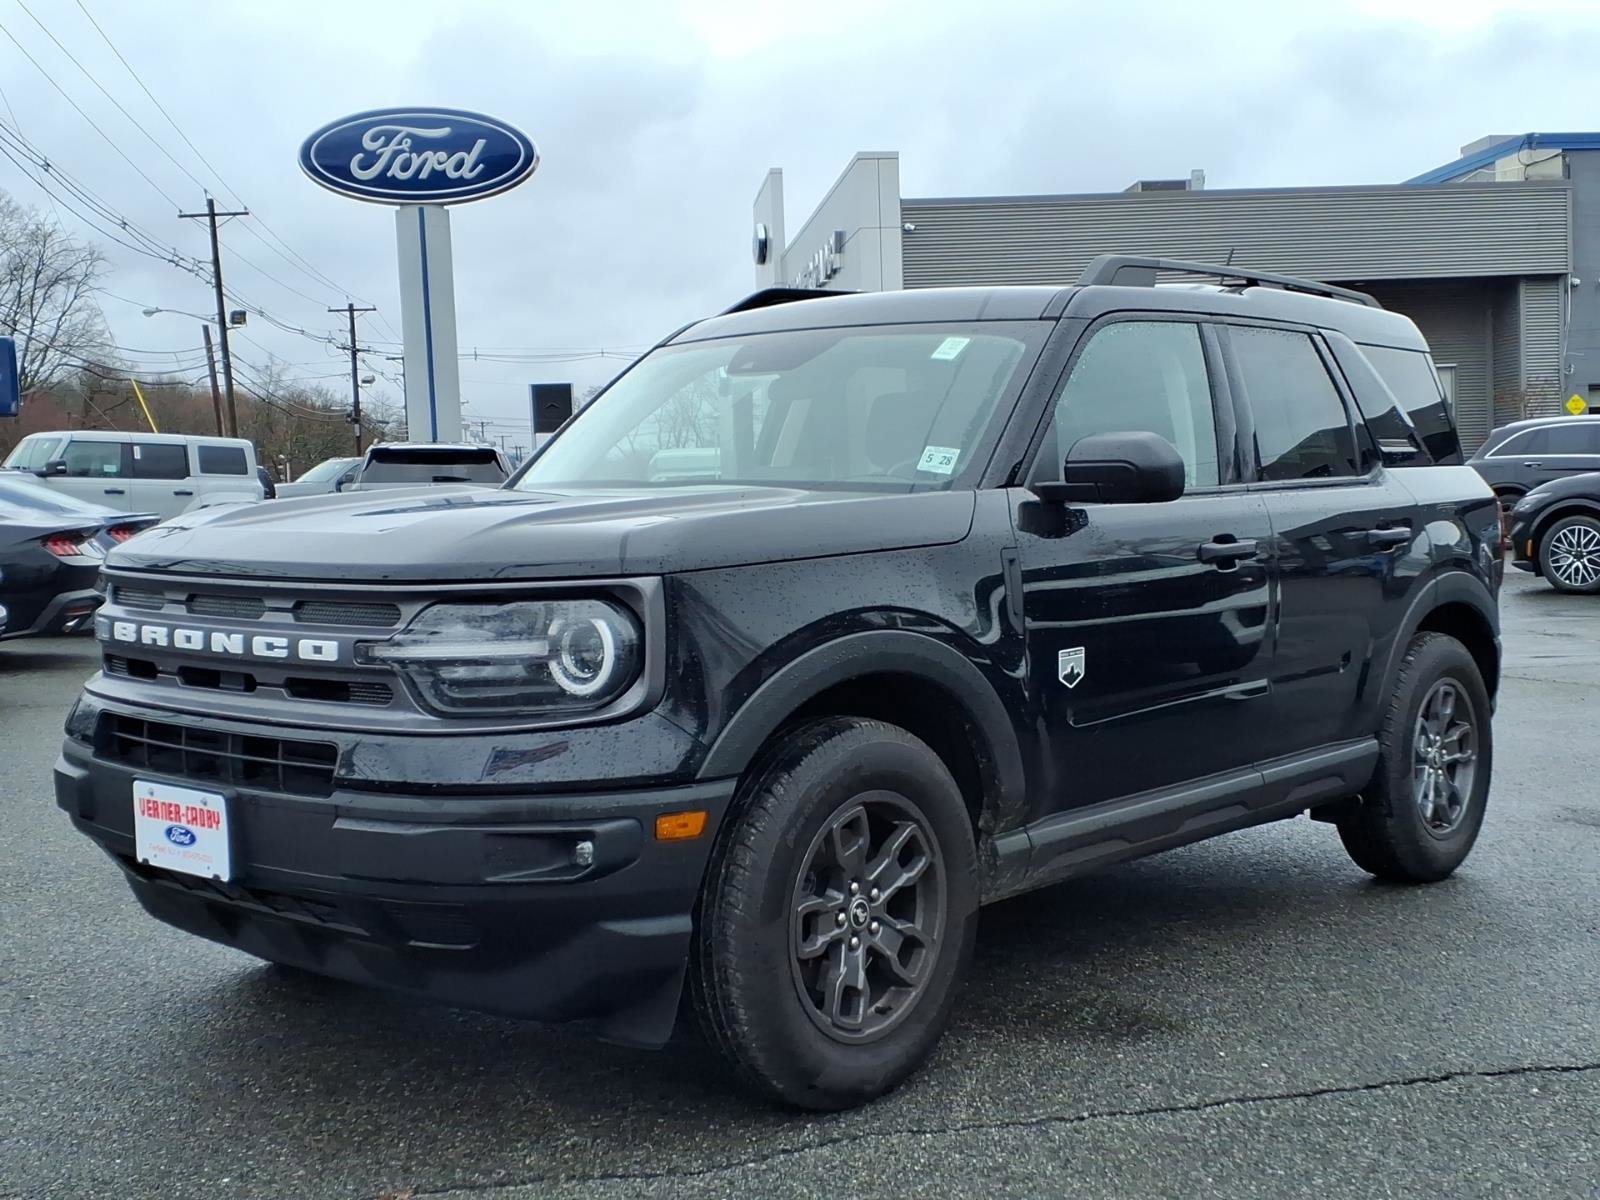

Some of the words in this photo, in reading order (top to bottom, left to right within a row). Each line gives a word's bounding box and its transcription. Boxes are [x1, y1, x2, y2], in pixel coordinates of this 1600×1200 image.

[350, 125, 486, 180] Ford
[926, 453, 934, 463] 5
[939, 455, 953, 466] 28
[113, 621, 338, 661] BRONCO
[170, 827, 191, 844] Ford
